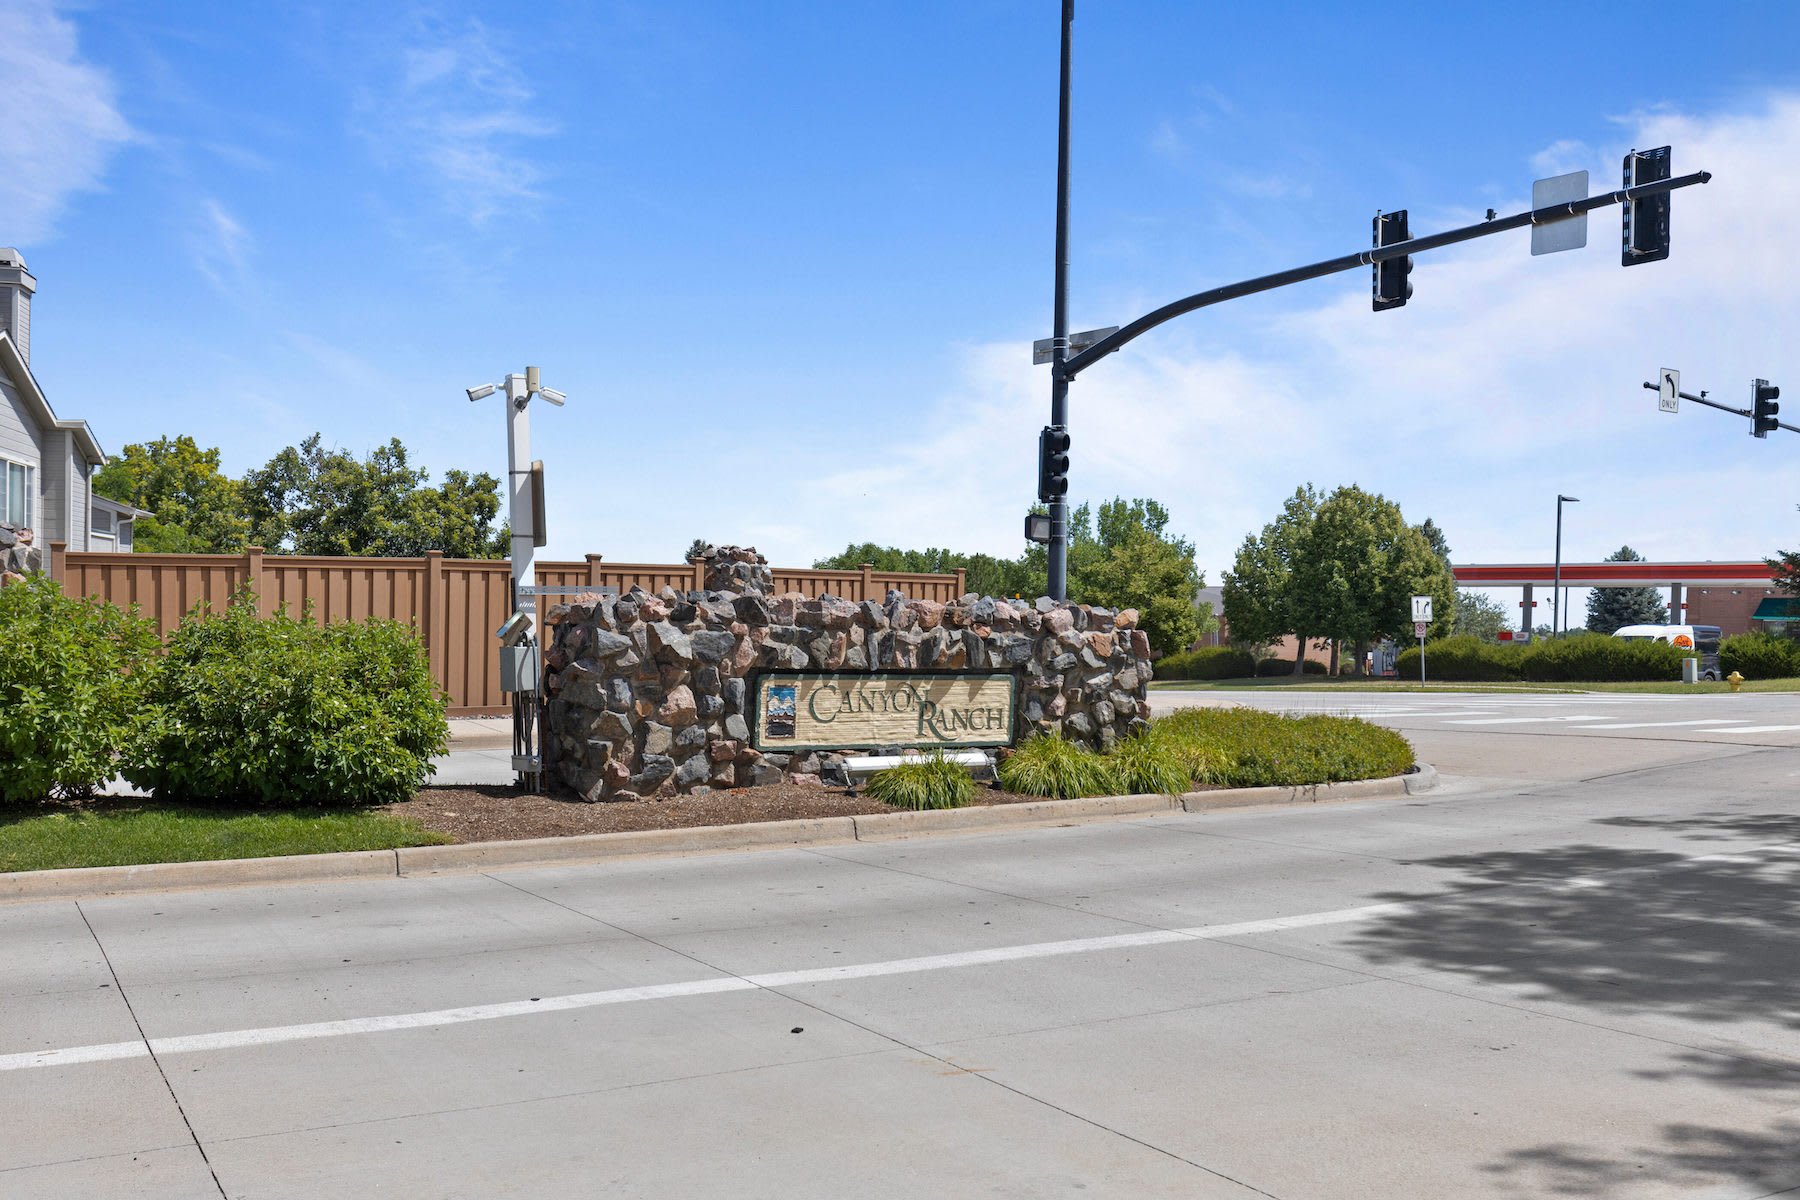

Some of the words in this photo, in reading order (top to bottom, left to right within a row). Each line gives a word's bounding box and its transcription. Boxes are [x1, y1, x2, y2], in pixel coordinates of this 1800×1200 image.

[1661, 399, 1677, 409] ONLY
[809, 682, 930, 723] CANYON
[914, 700, 1004, 741] RANCH
